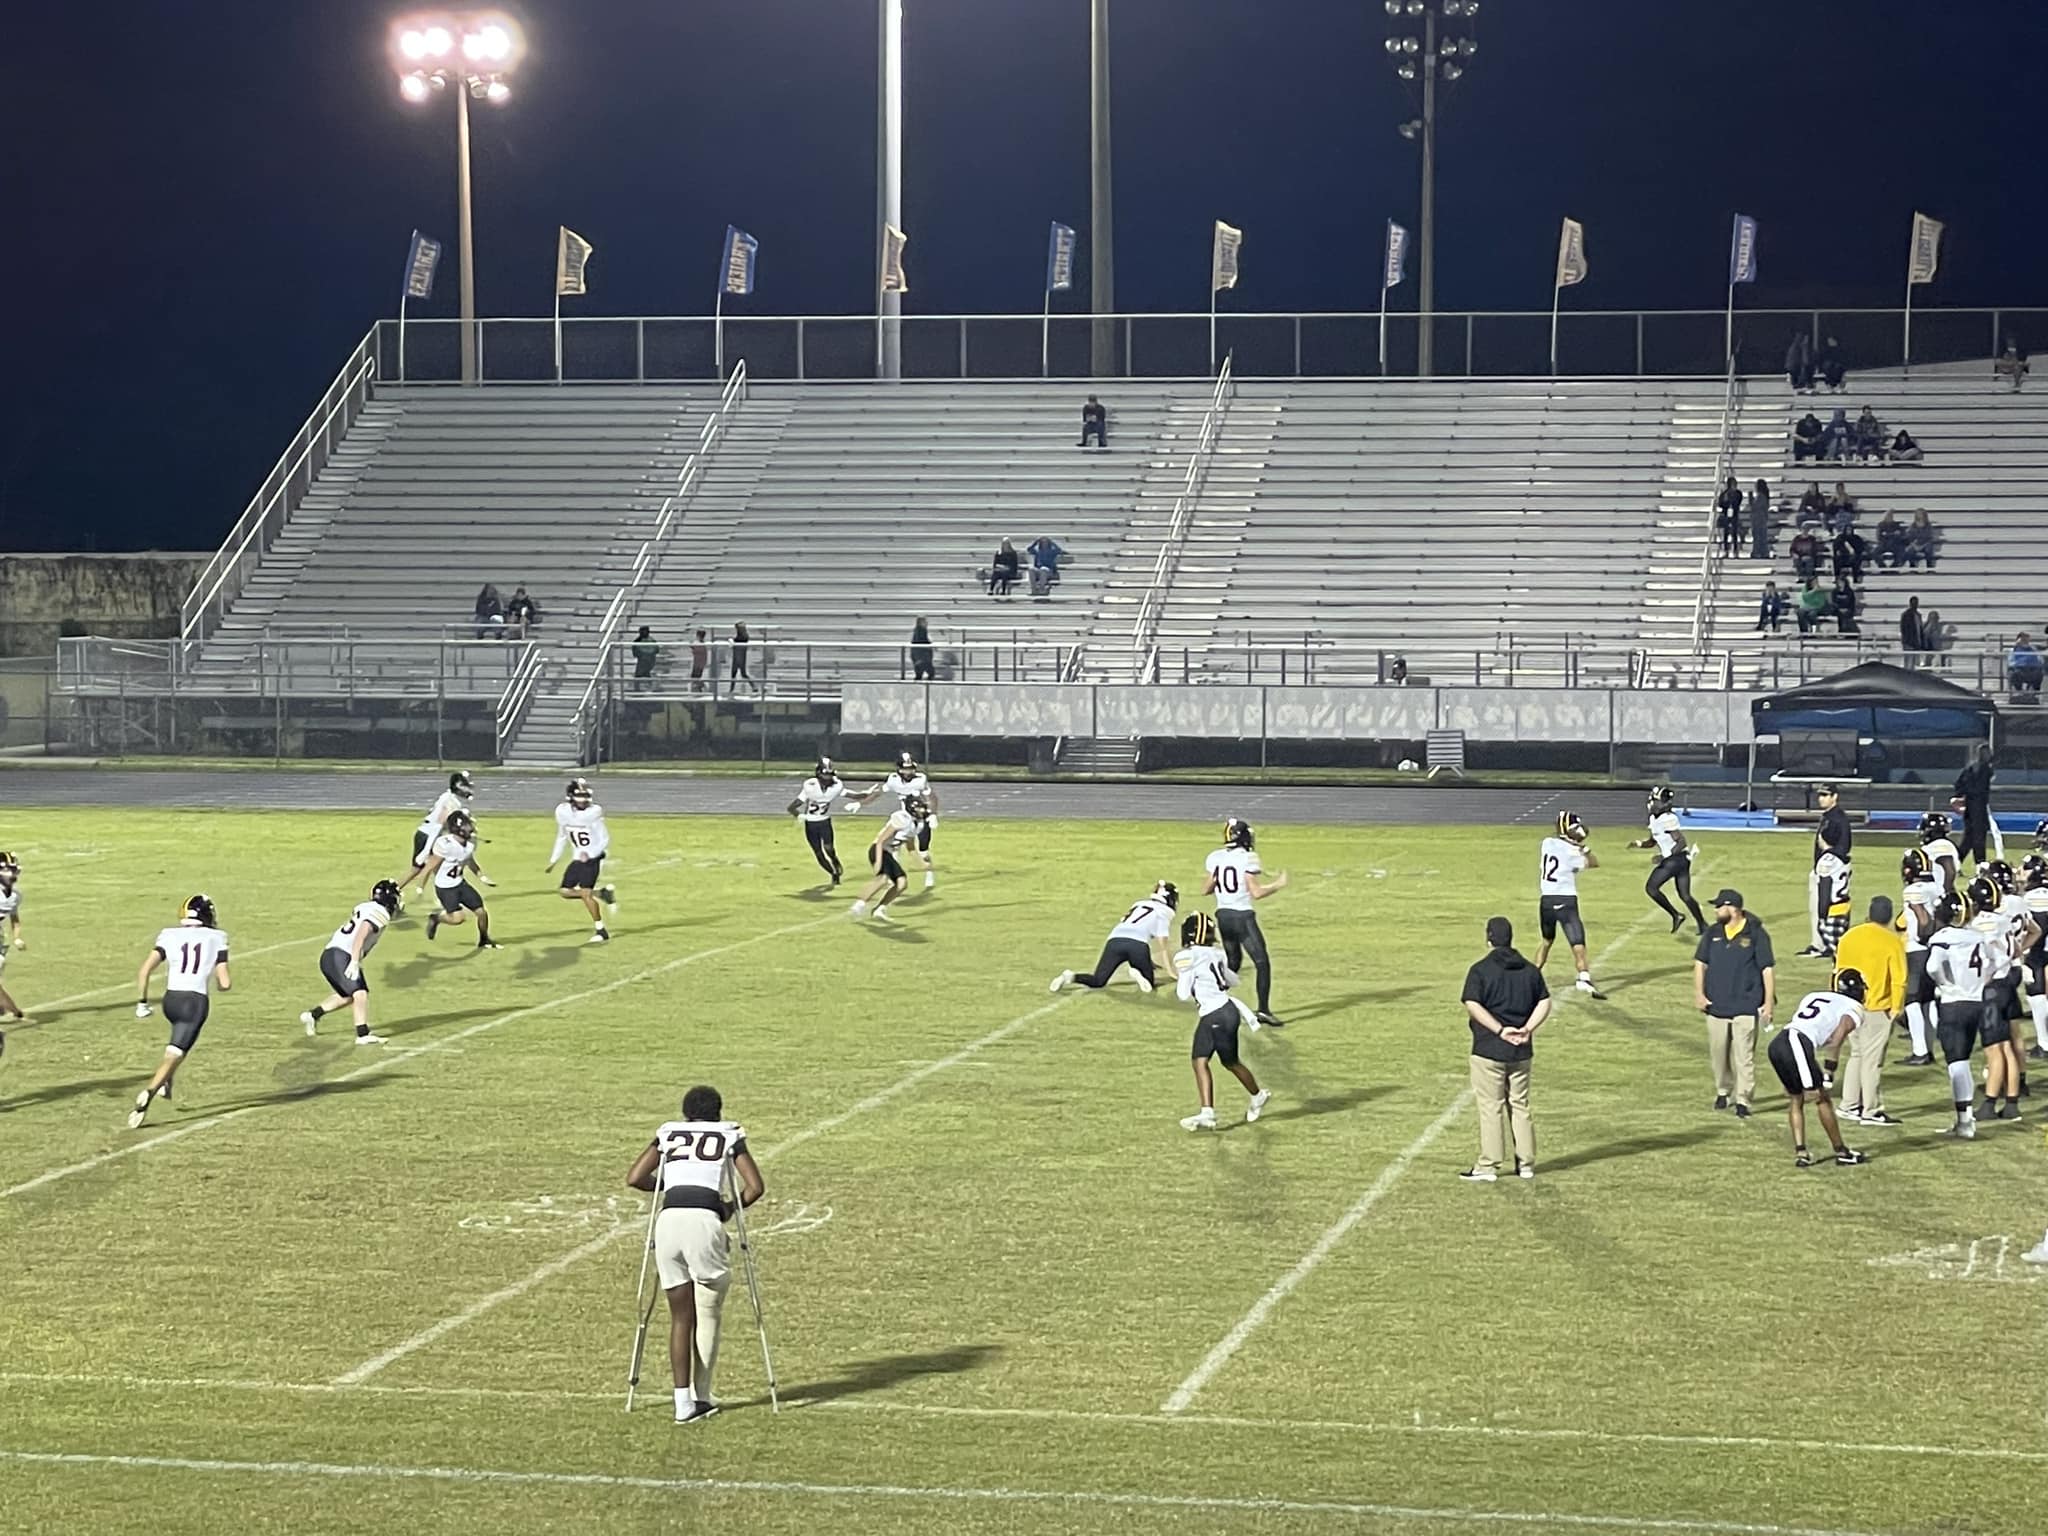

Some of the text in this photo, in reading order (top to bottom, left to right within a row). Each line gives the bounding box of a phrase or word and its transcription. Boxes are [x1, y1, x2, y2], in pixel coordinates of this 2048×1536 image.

[568, 830, 591, 849] 16
[1543, 853, 1559, 883] 12
[180, 942, 202, 975] 11
[1797, 998, 1831, 1020] 5
[665, 1130, 727, 1163] 20
